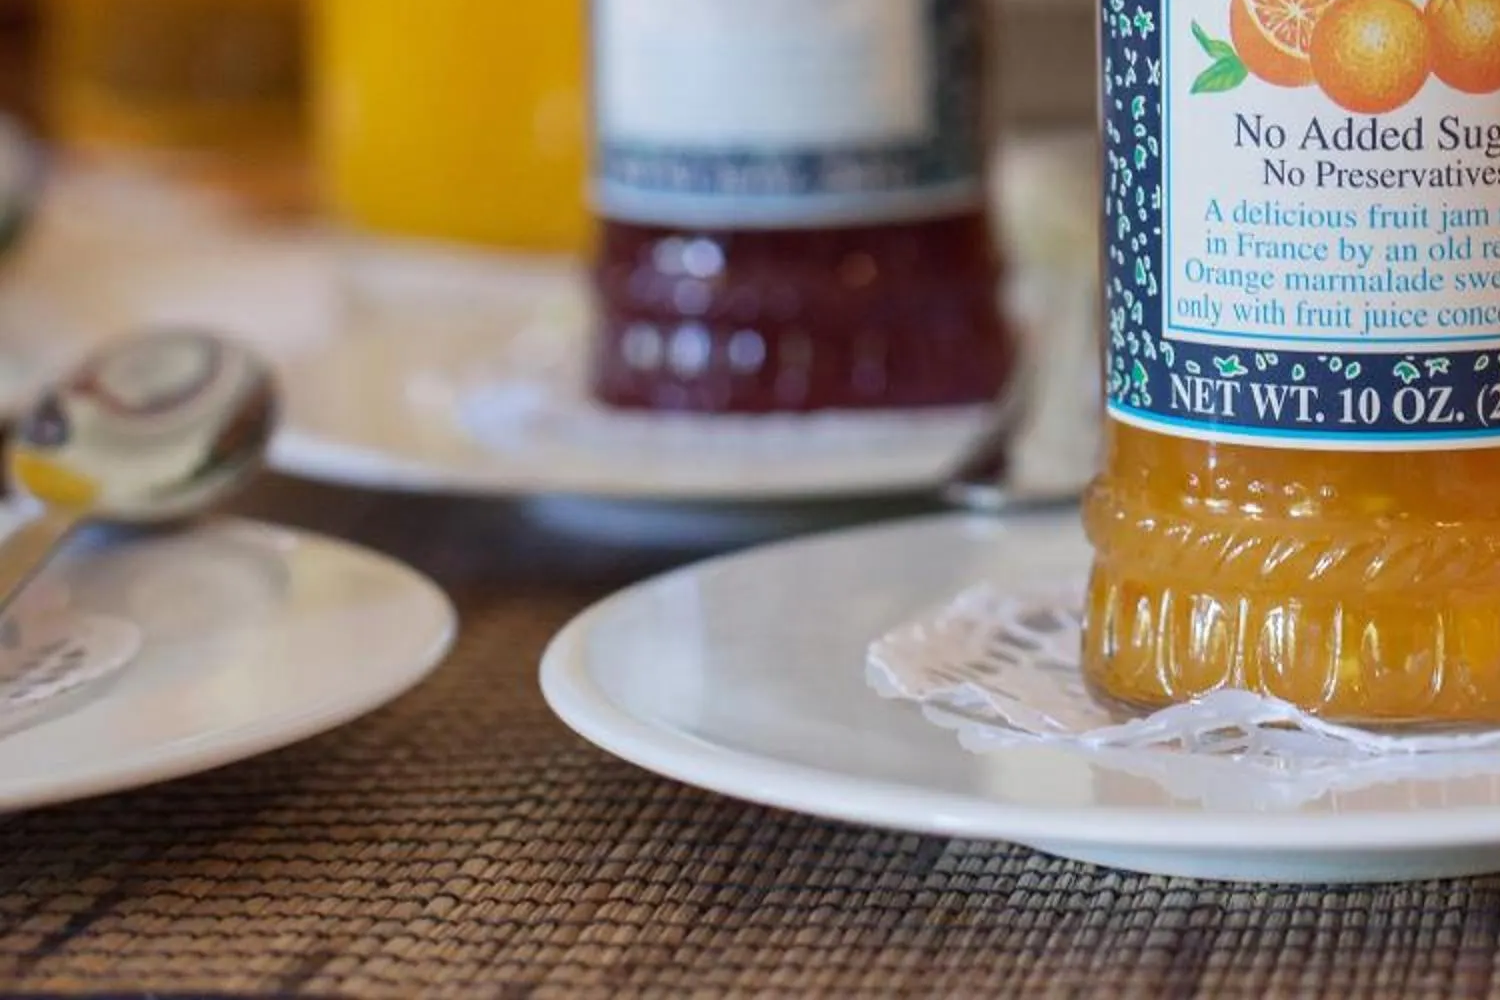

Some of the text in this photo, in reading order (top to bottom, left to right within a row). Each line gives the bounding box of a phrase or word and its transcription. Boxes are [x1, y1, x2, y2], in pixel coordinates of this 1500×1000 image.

[1233, 113, 1287, 149] No
[1301, 116, 1424, 151] Added
[1263, 158, 1305, 186] No
[1204, 199, 1223, 223] A
[1233, 200, 1358, 229] delicious
[1368, 202, 1430, 229] fruit
[1437, 202, 1490, 235] jam
[1206, 229, 1228, 256] in
[1237, 232, 1329, 263] France
[1339, 236, 1374, 269] by
[1385, 242, 1418, 263] an
[1428, 234, 1473, 262] old
[1184, 258, 1275, 293] Orange
[1285, 266, 1445, 294] marmalade
[1177, 294, 1223, 328] only
[1233, 299, 1285, 327] with
[1297, 300, 1353, 328] fruit
[1360, 300, 1428, 336] juice
[1170, 372, 1240, 417] NET
[1250, 384, 1325, 424] WT.
[1338, 388, 1381, 423] 10
[1393, 387, 1465, 424] OZ.
